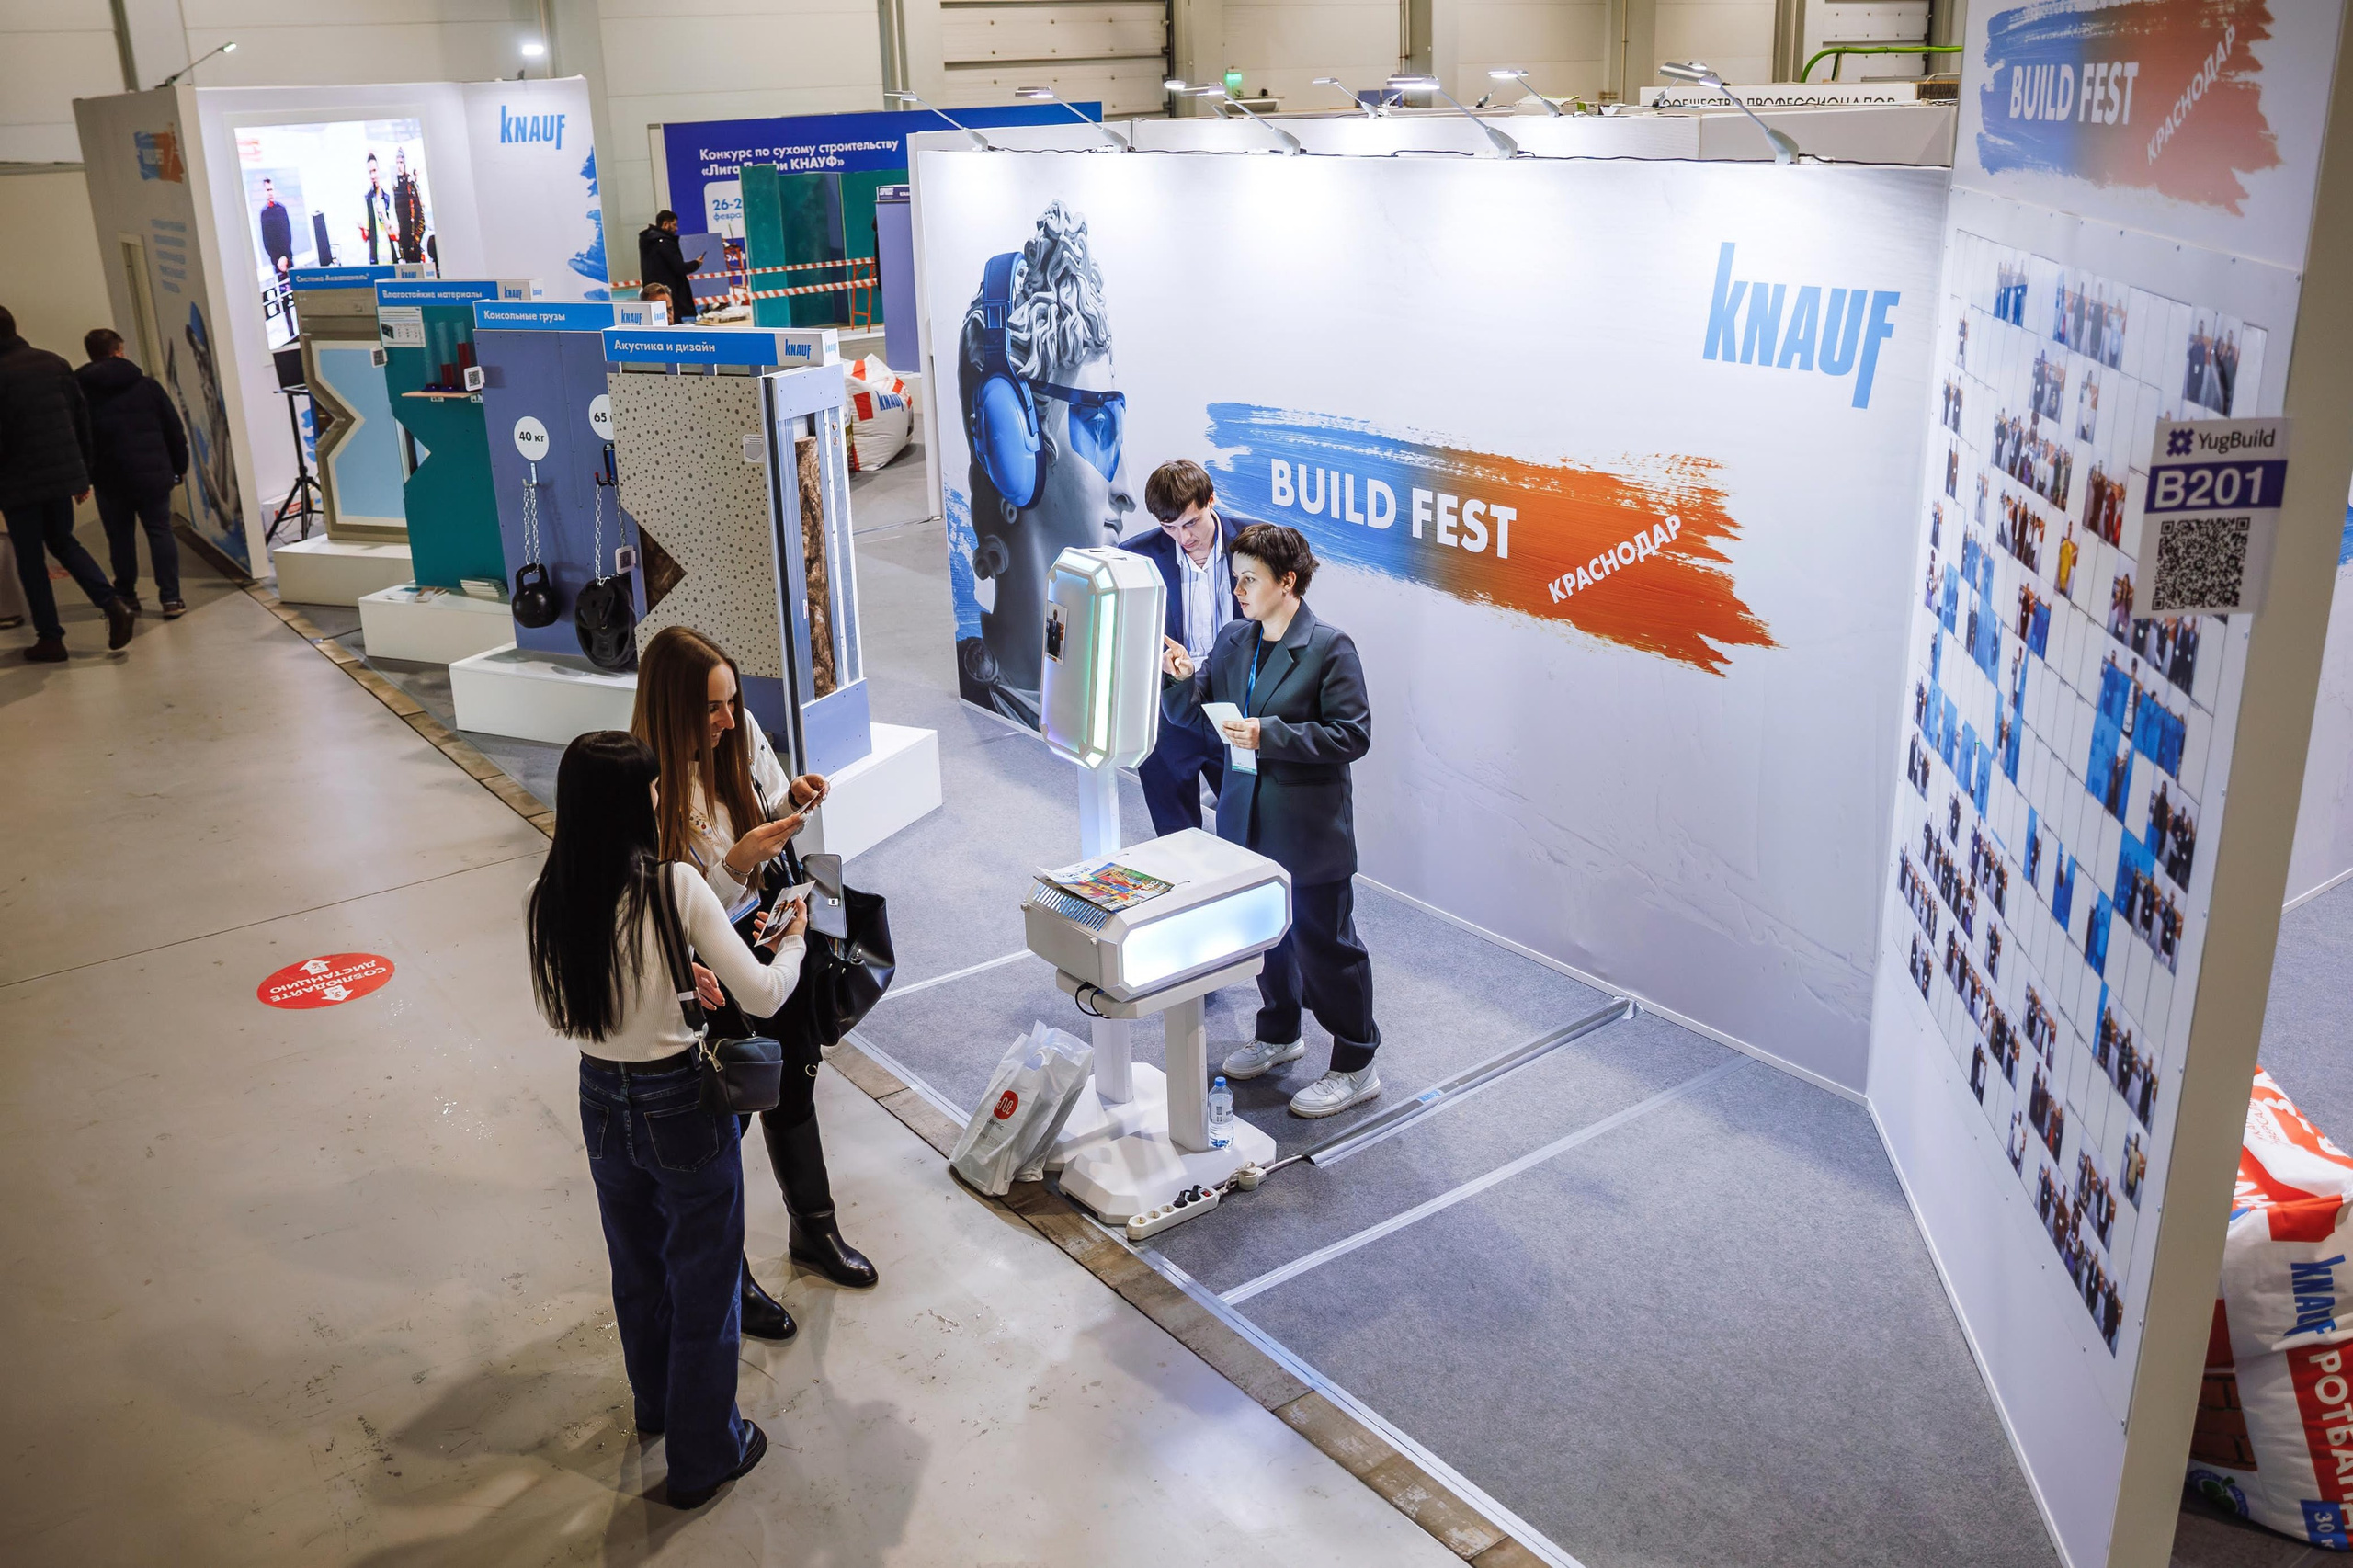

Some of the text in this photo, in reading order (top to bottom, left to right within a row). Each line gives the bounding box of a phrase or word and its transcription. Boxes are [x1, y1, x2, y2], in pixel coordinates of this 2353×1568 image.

[1655, 98, 1742, 107] ООБЩЕСТВО
[2009, 62, 2140, 126] BUILD FEST
[2145, 25, 2237, 166] КРАСНОДАР
[500, 105, 566, 150] KNAUF
[699, 140, 899, 161] Конкурс по сухому строительству
[790, 155, 845, 171] КНАУФ»
[712, 197, 743, 211] 26-2
[713, 211, 743, 222] февра
[382, 290, 483, 301] Влагостойкие материалы
[504, 285, 523, 301] KNAUF
[483, 310, 566, 324] Консольные грузы
[620, 309, 643, 325] KNAUF
[1702, 241, 1901, 410] KNAUF
[614, 339, 716, 355] Акустика и дизайн
[785, 339, 812, 361] KNAUF
[594, 412, 607, 423] 65
[518, 431, 545, 443] 40 кг
[2198, 427, 2276, 454] YugBuild
[2154, 467, 2264, 509] B201
[1270, 458, 1518, 560] BUILD FEST
[1547, 515, 1682, 605] КРАСНОДАР
[269, 960, 377, 994] ДИСТАНЦИЮ
[269, 967, 387, 1003] СОБЛЮДАЙТЕ
[2283, 1254, 2346, 1337] KNAUF
[2313, 1511, 2336, 1533] 30
